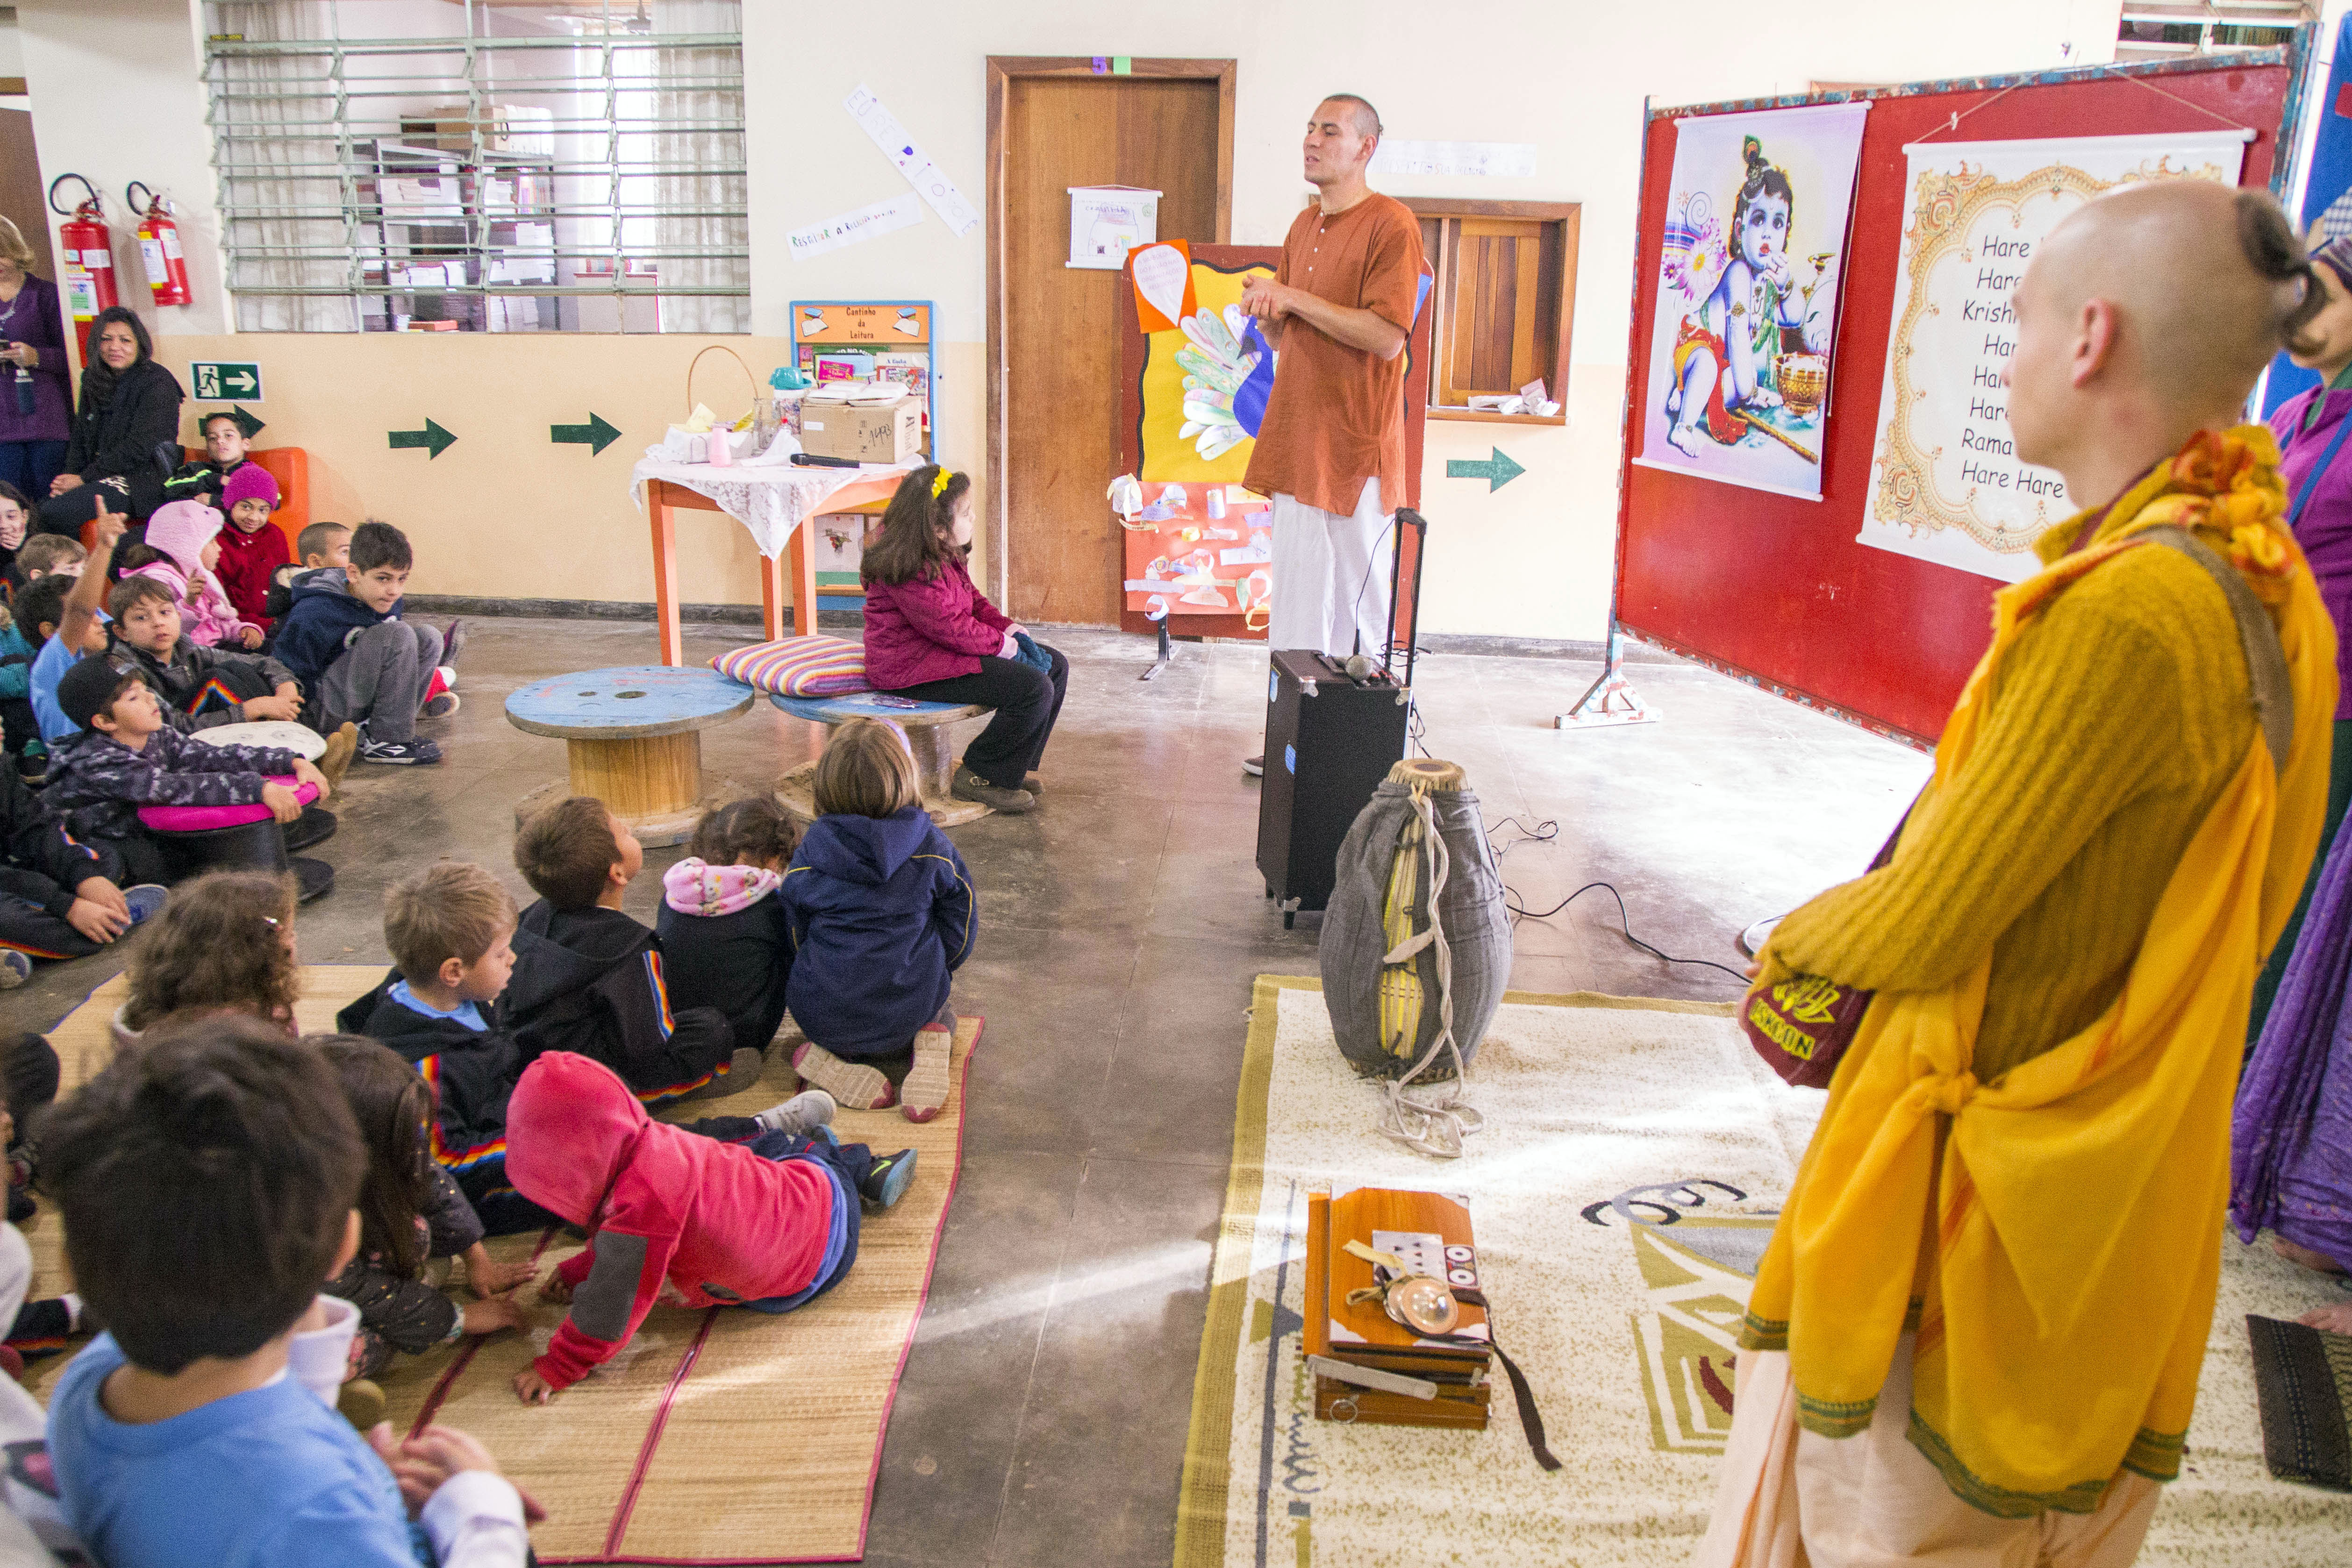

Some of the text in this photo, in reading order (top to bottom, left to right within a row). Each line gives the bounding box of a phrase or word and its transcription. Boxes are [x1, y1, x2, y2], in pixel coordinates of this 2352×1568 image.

[1982, 235, 2030, 257] Hare
[846, 306, 876, 315] Cantinho
[1963, 299, 2016, 324] Krish
[850, 330, 874, 339] Leitura
[1984, 333, 2017, 356] Har
[1961, 428, 2012, 455] Rama
[1961, 459, 2064, 498] Hare Hare
